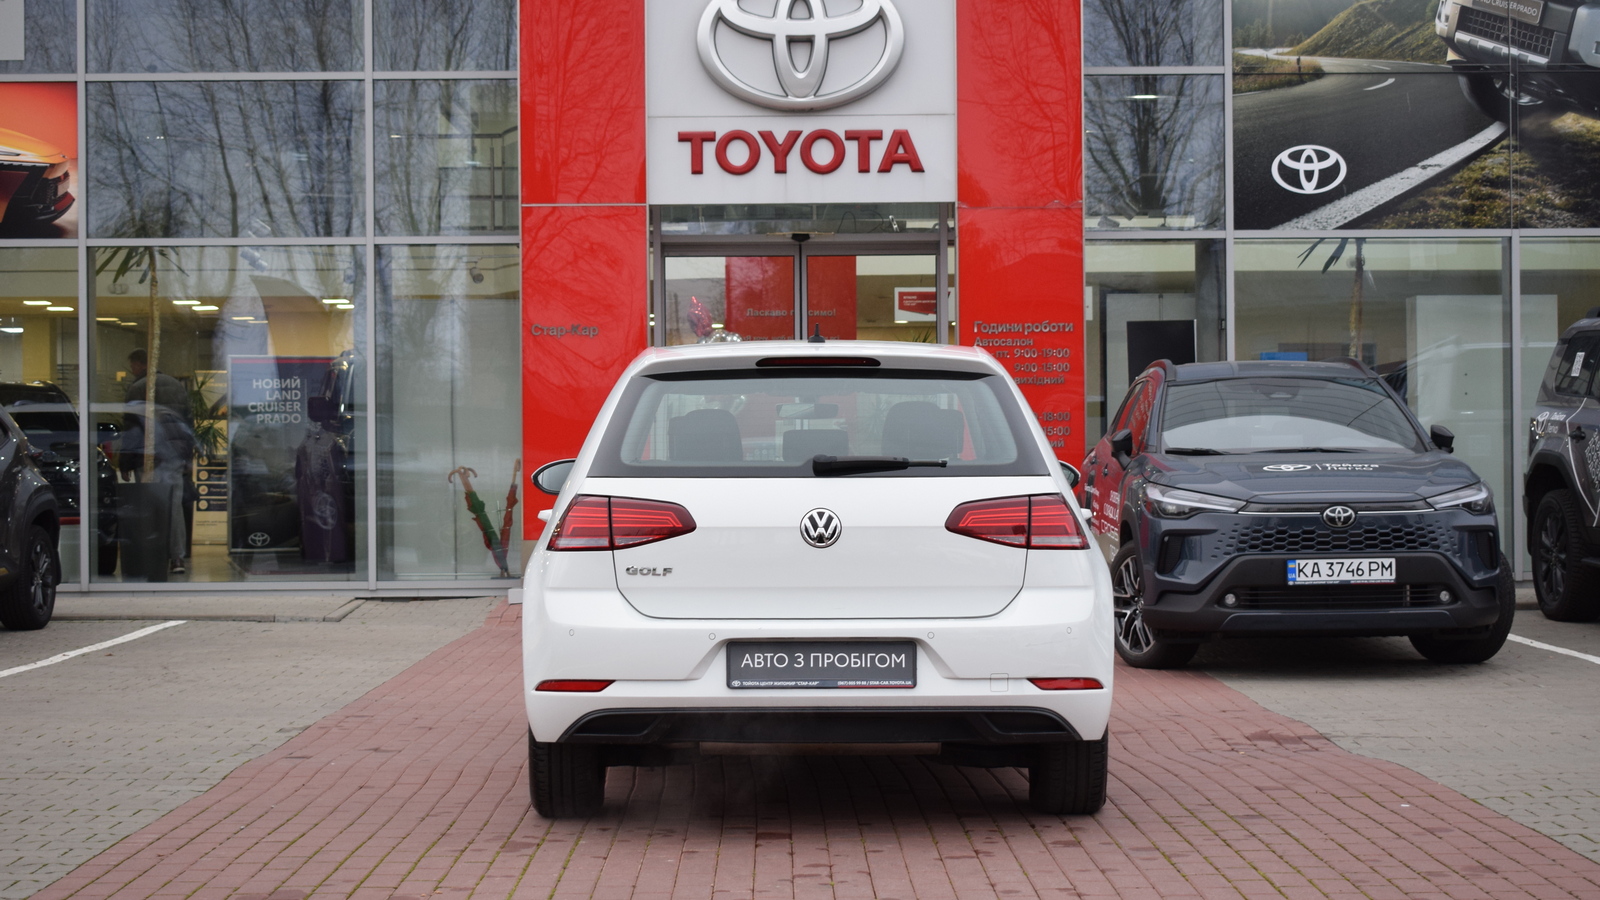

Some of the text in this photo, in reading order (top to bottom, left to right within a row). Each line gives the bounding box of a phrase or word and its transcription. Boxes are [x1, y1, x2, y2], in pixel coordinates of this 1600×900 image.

[1517, 5, 1537, 16] PRADO
[678, 129, 925, 175] TOYOTA
[746, 308, 787, 317] Ласкаво
[531, 324, 598, 338] Стар-Кар
[974, 321, 1073, 335] Години роботи
[974, 337, 1033, 346] Автосалон
[995, 350, 1010, 358] пт.
[253, 376, 301, 389] НОВИЙ
[1014, 375, 1064, 385] вихідний
[266, 390, 301, 400] LAND
[248, 402, 301, 412] CRUISER
[256, 413, 301, 424] PRADO
[625, 566, 673, 577] GOLF
[1326, 561, 1365, 578] 3746
[741, 653, 789, 668] АВТО
[810, 653, 906, 668] ПРОБІГОМ
